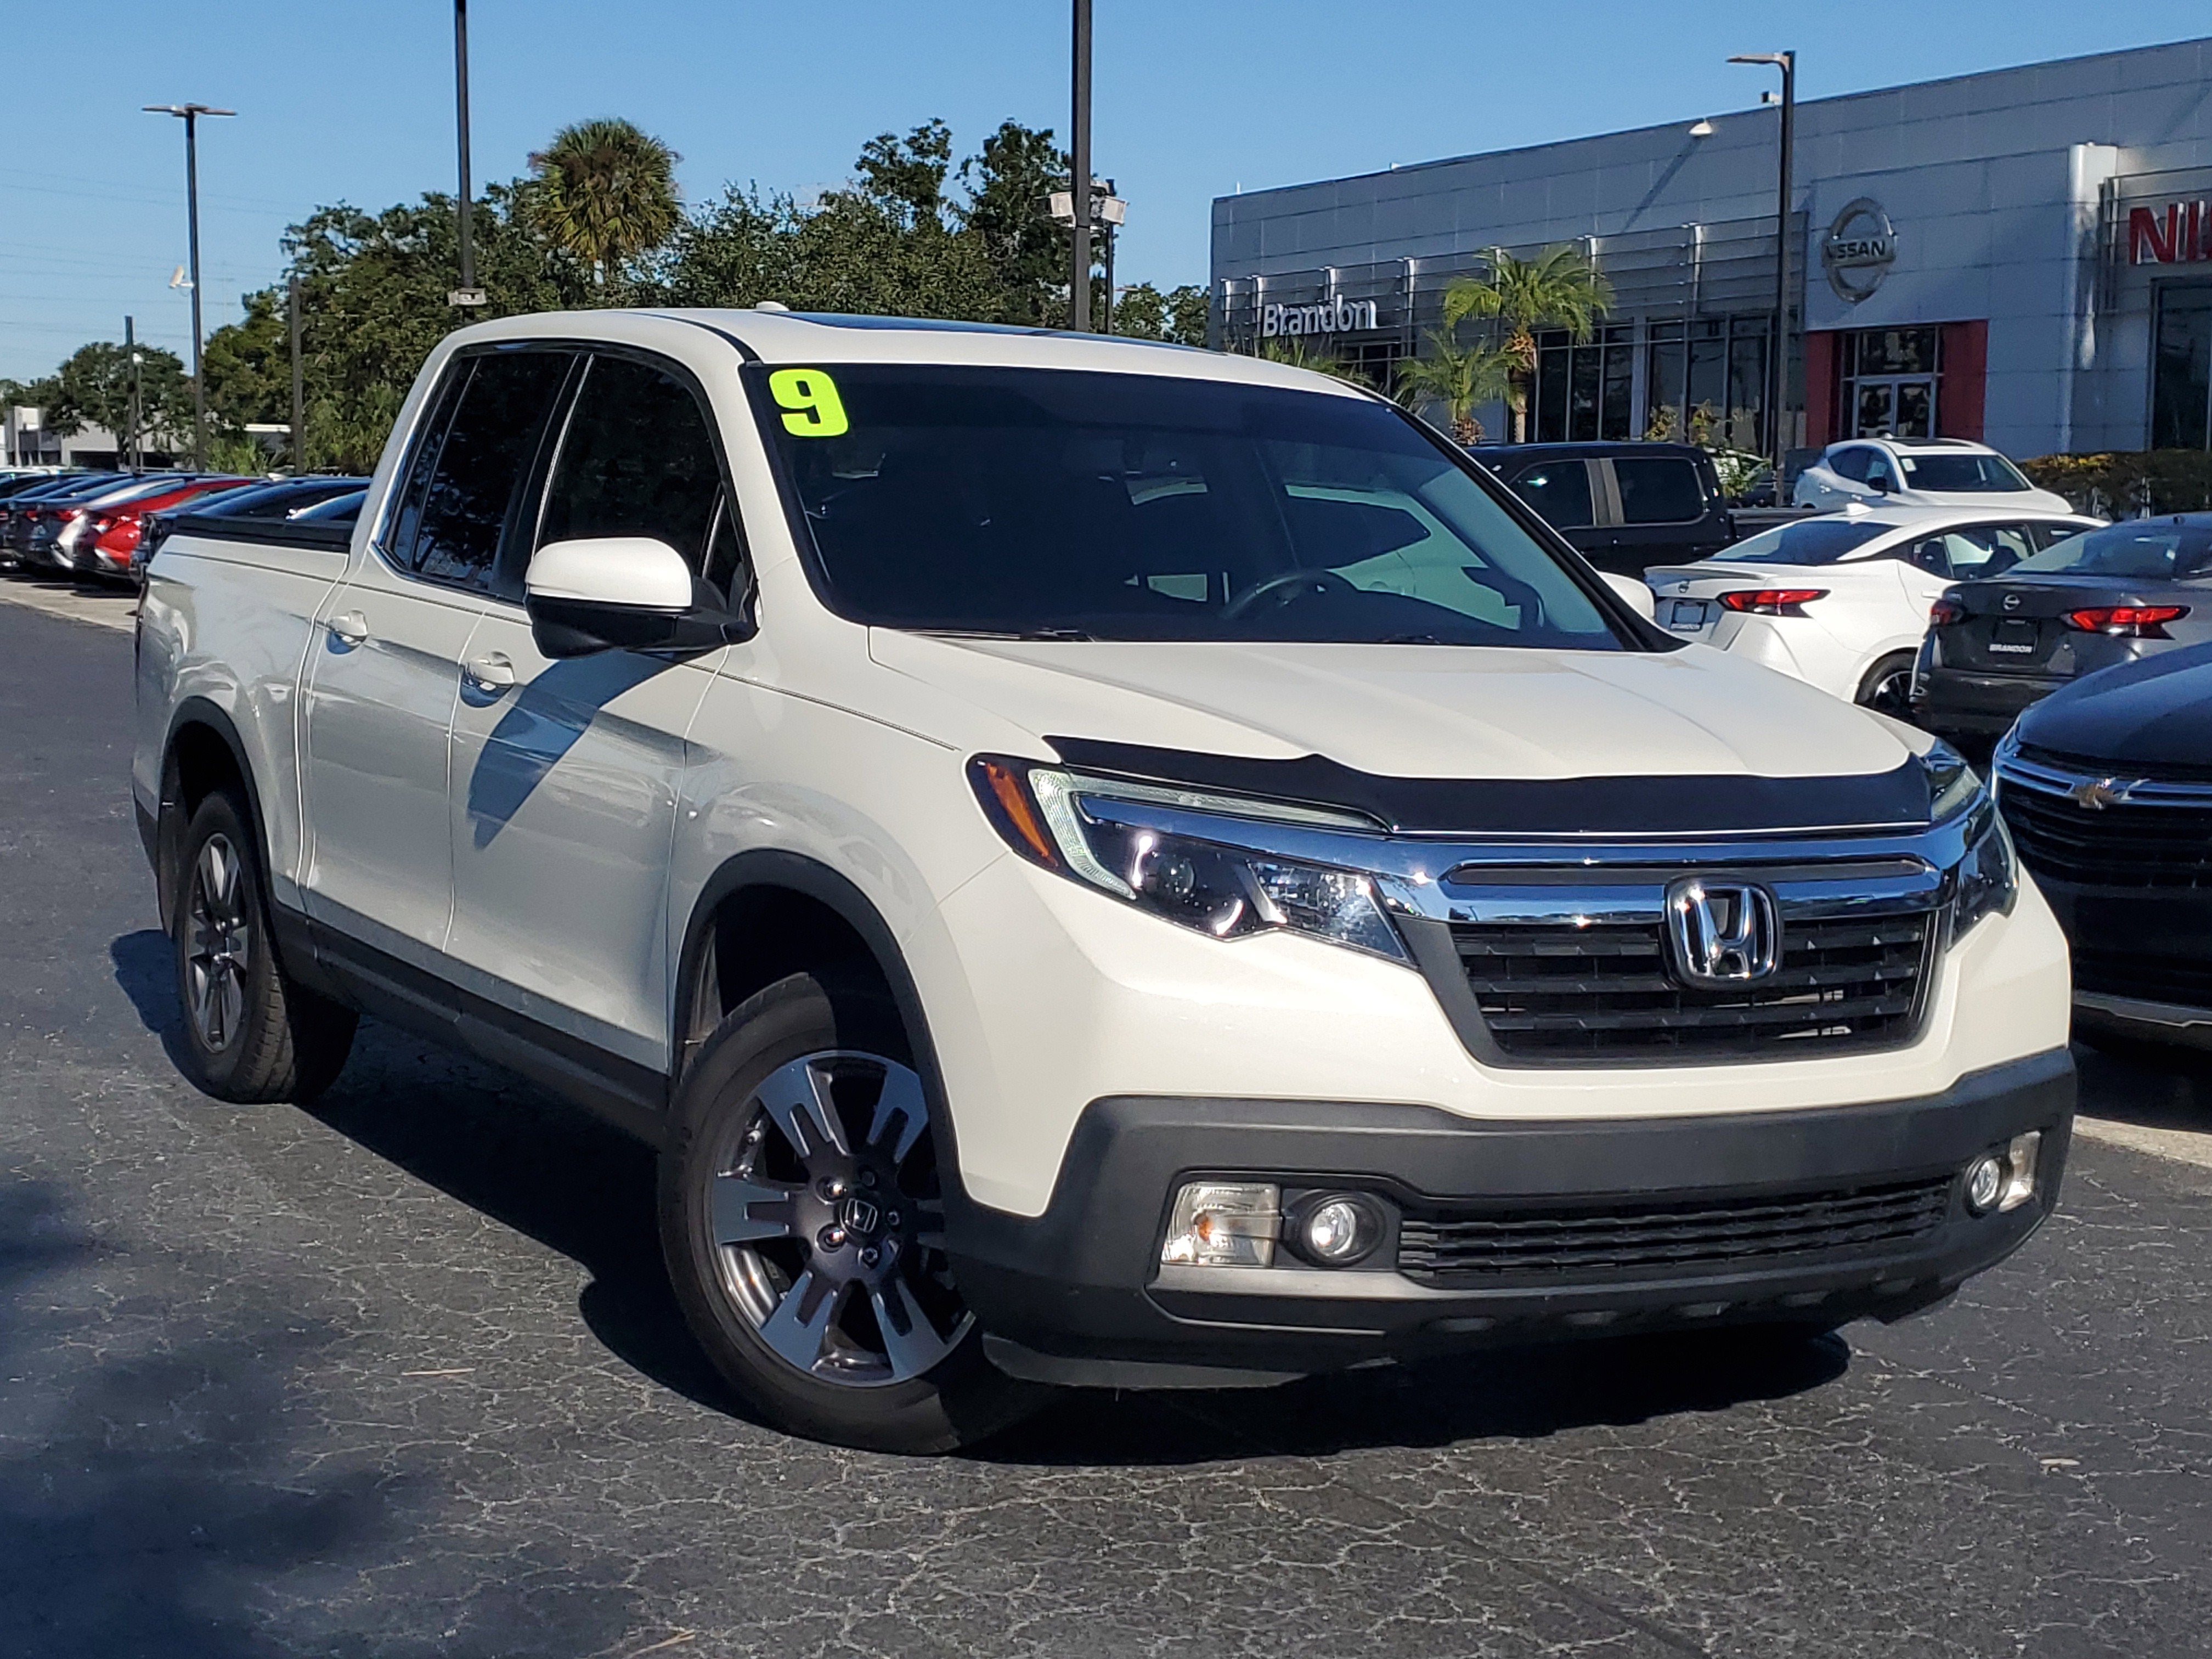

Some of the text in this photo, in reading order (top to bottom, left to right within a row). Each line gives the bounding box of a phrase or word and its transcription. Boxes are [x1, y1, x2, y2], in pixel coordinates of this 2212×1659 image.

[2129, 200, 2212, 264] NI
[1263, 295, 1377, 337] Brandon
[769, 369, 848, 437] 9
